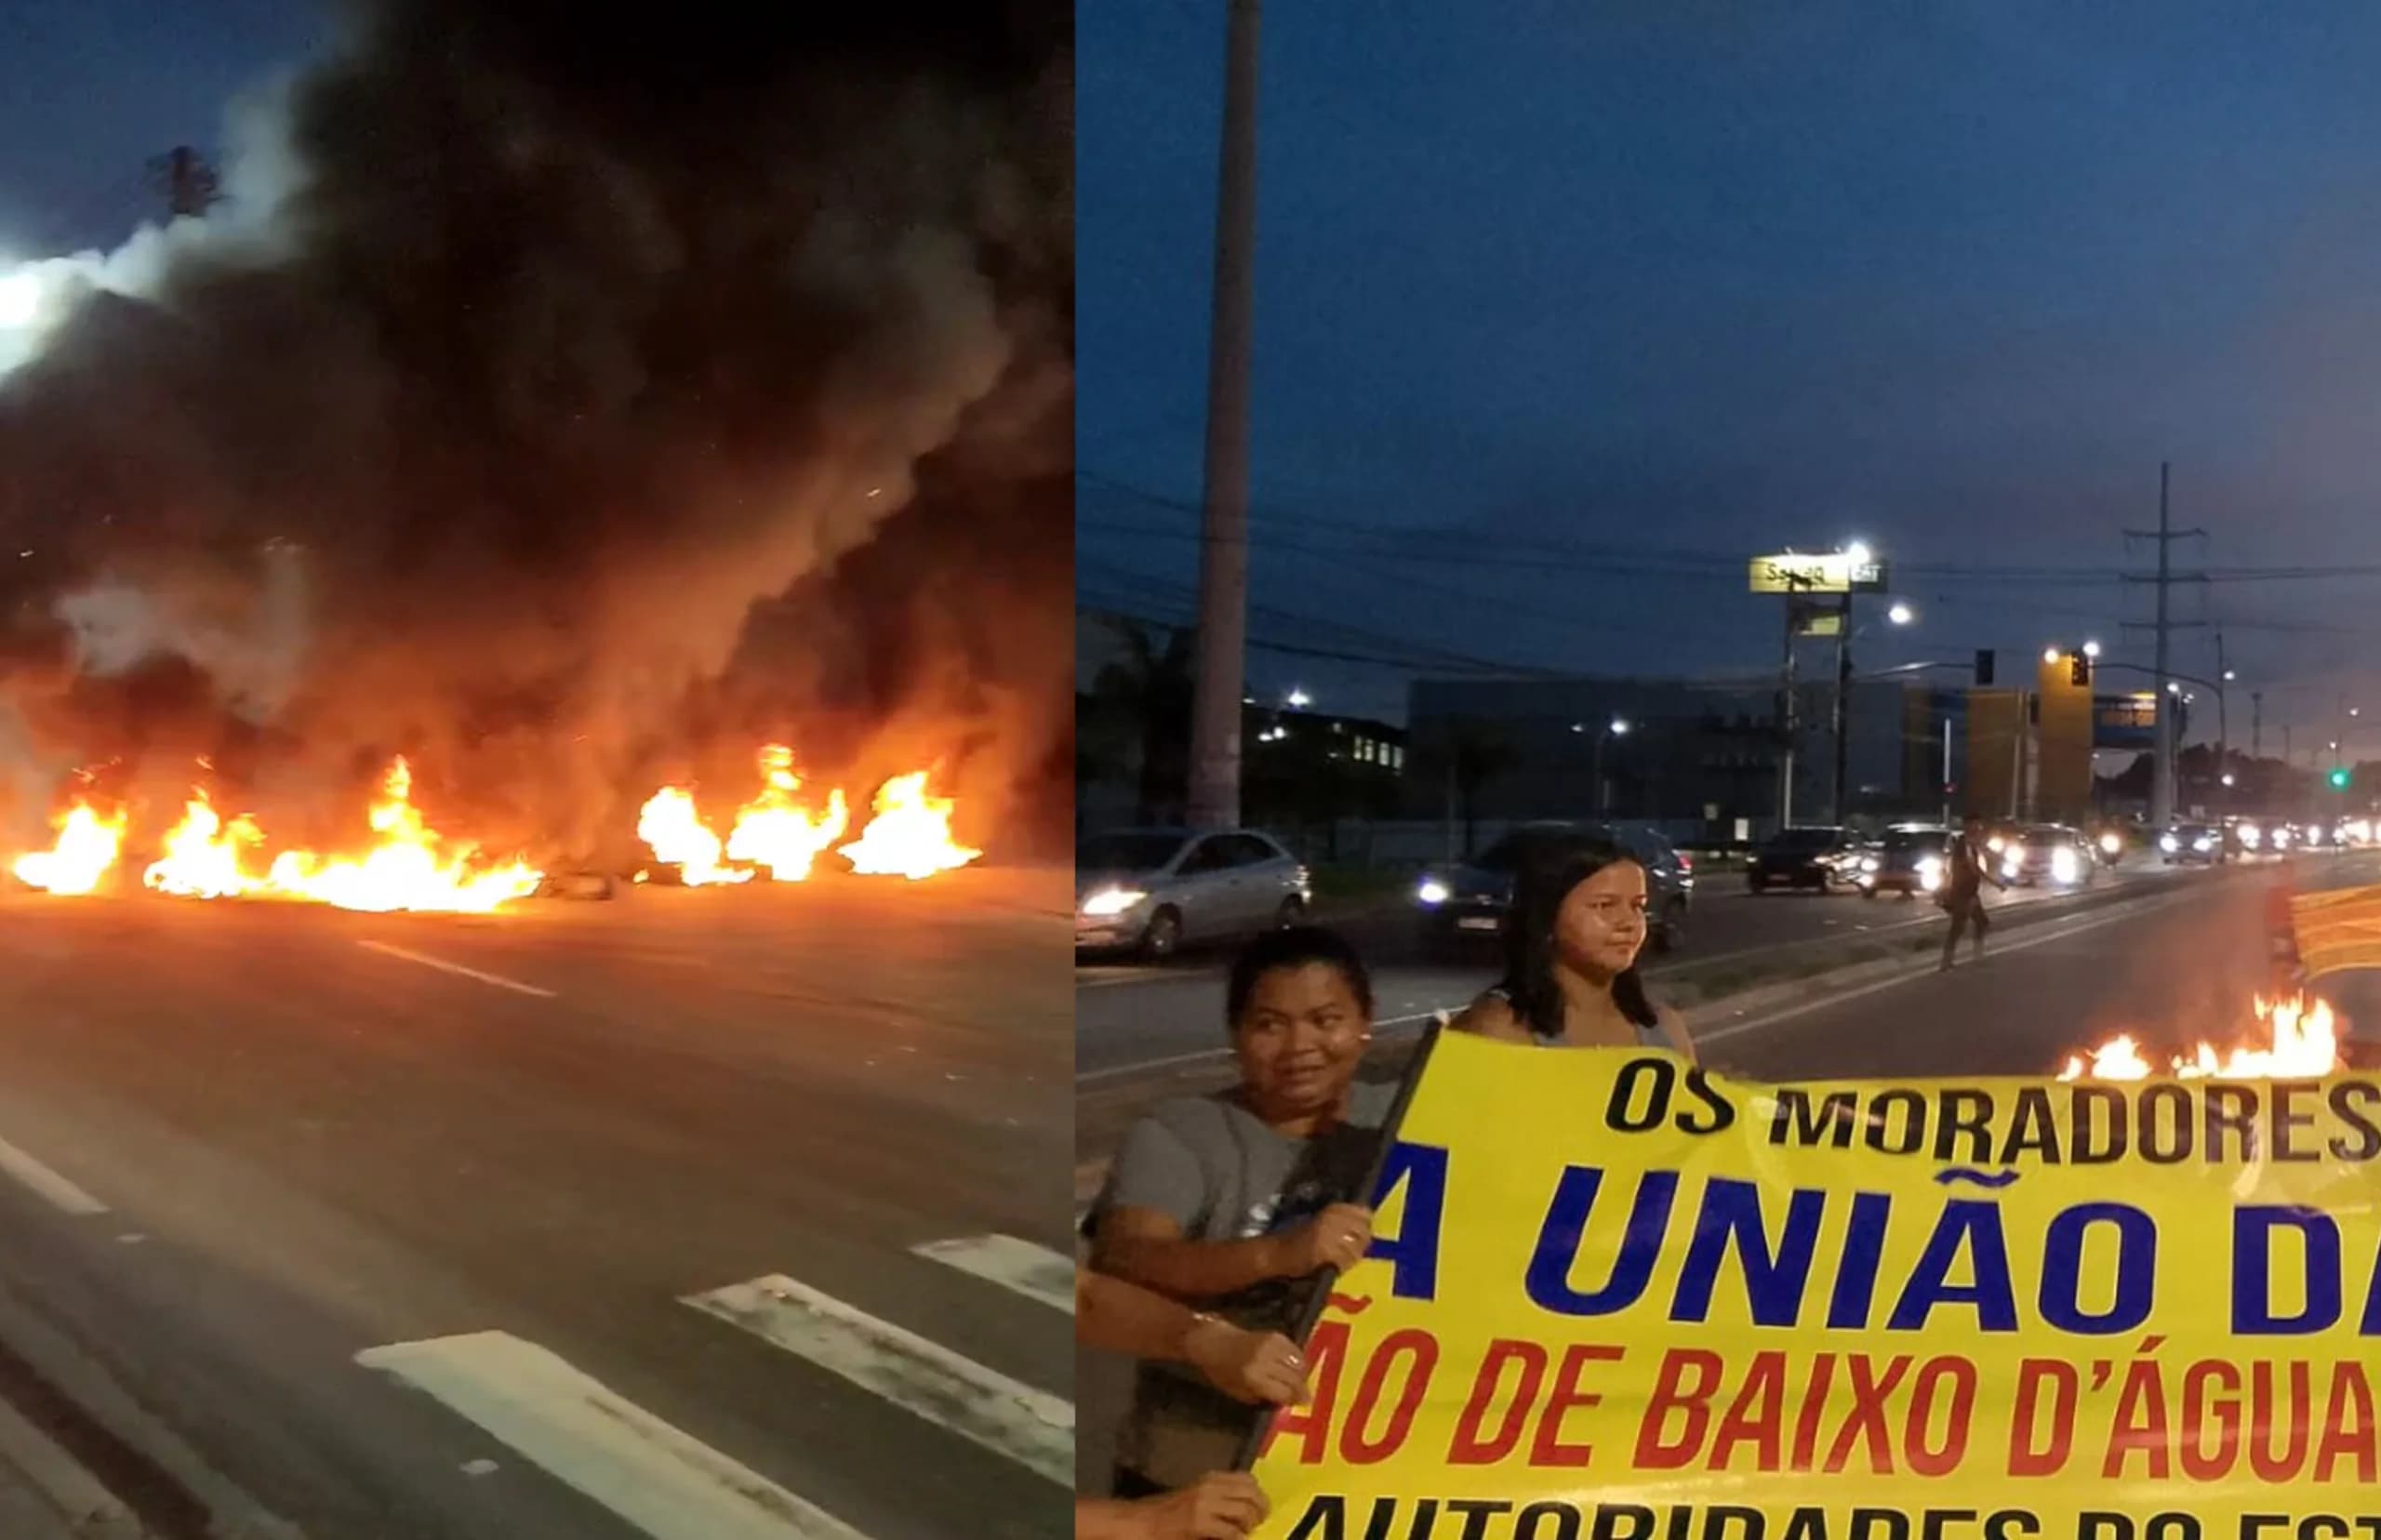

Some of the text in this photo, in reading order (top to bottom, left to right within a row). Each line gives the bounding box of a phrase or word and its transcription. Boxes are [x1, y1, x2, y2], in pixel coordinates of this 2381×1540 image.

[1606, 1058, 2381, 1165] OS MORADORES
[1525, 1167, 2157, 1335] UNIÃO
[2231, 1204, 2381, 1335] D
[1447, 1339, 1624, 1469] DE
[1632, 1348, 1977, 1479] BAIXO
[2007, 1335, 2378, 1484] D'ÁGUA
